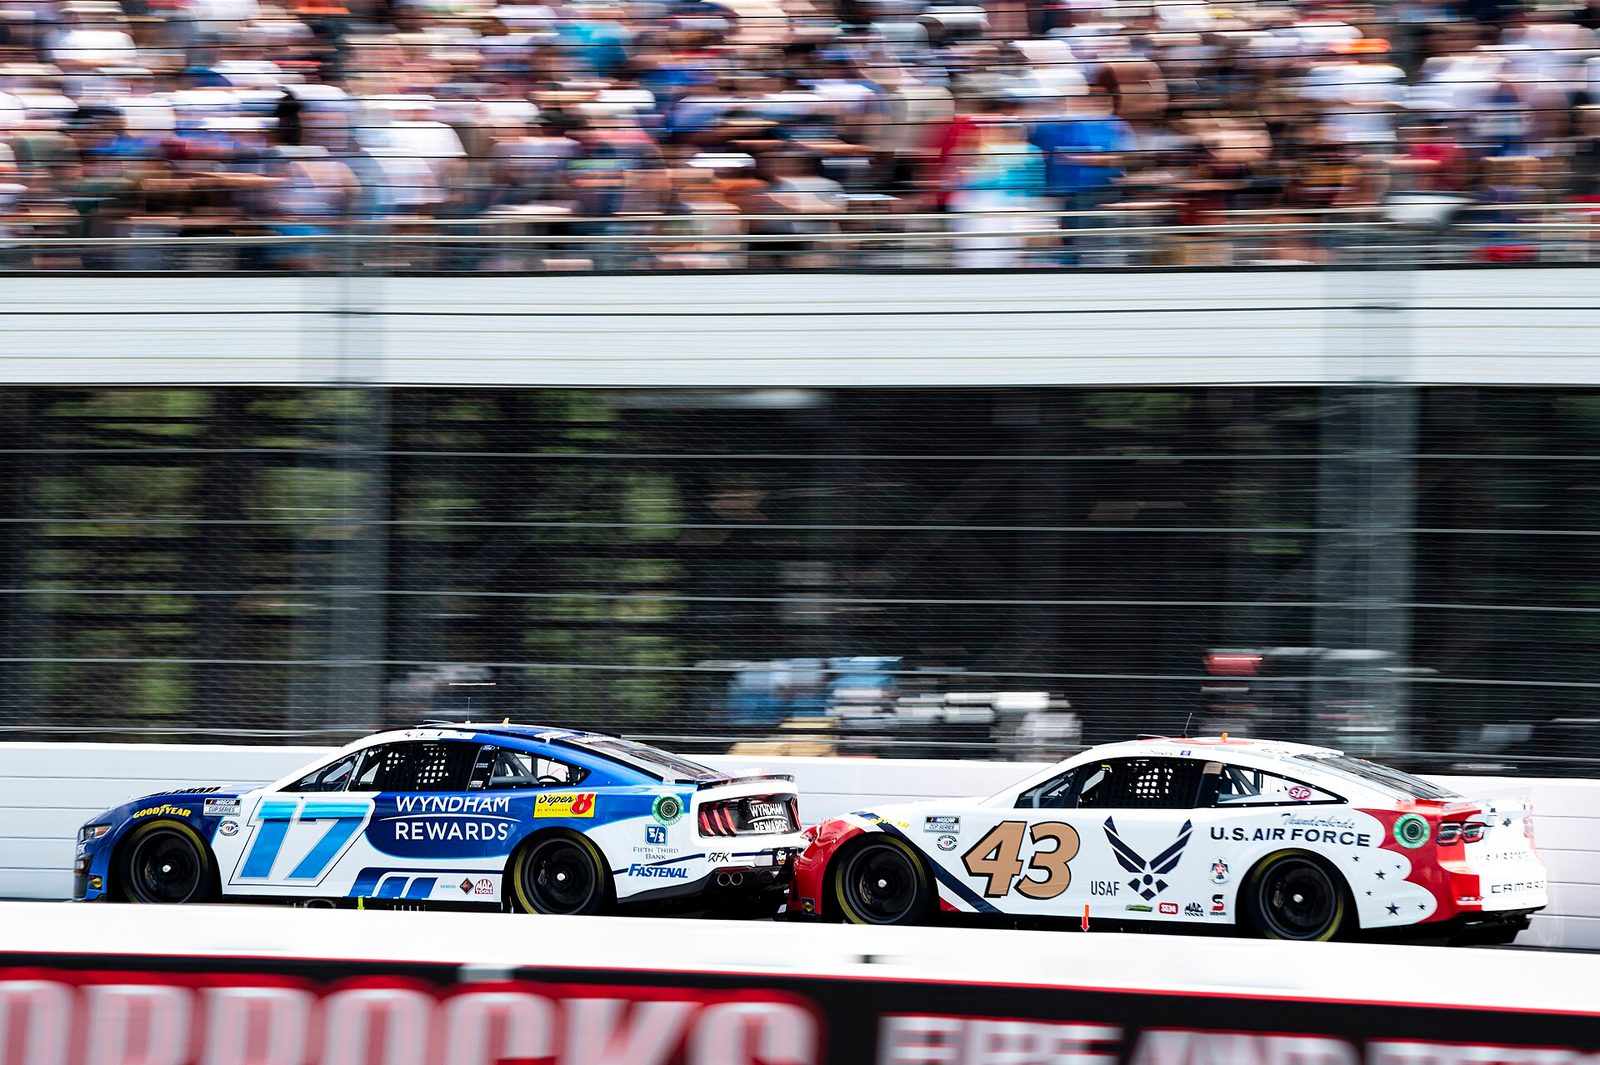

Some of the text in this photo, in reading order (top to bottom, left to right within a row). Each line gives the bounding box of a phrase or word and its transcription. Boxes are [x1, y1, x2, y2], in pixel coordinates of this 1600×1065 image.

[1290, 786, 1310, 798] STP
[133, 804, 192, 819] GOODYEAR
[395, 795, 510, 813] WYNDHAM
[538, 793, 595, 815] Super 8
[750, 802, 784, 818] WYNDHAM
[395, 821, 509, 842] REWARDS
[753, 819, 789, 832] REWARDS
[238, 799, 372, 881] 17
[1210, 826, 1371, 848] U.S. AIR FORCE
[961, 820, 1081, 900] 43
[628, 863, 689, 879] FASTENAL
[1090, 880, 1121, 897] USAF
